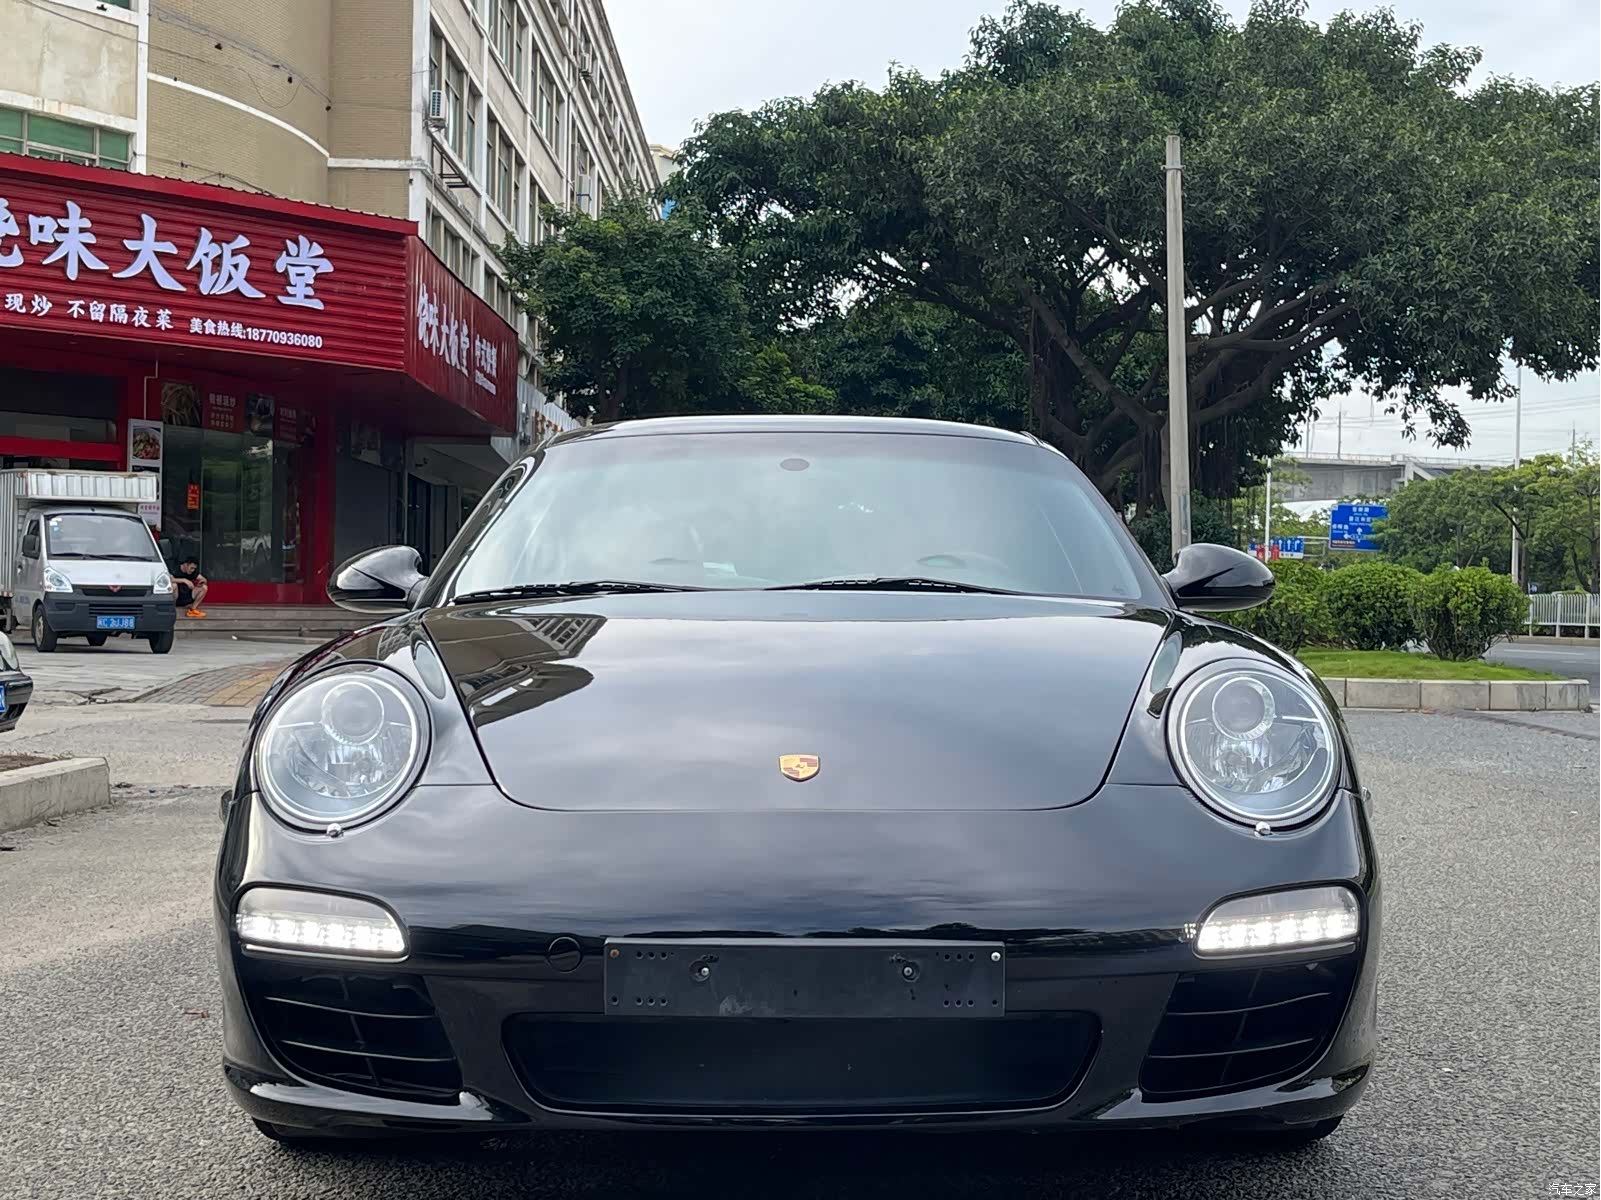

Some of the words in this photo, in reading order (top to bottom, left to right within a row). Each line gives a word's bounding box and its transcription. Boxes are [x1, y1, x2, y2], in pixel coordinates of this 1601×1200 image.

[5, 293, 52, 316] 现炒
[66, 299, 174, 331] 不留隔夜菜
